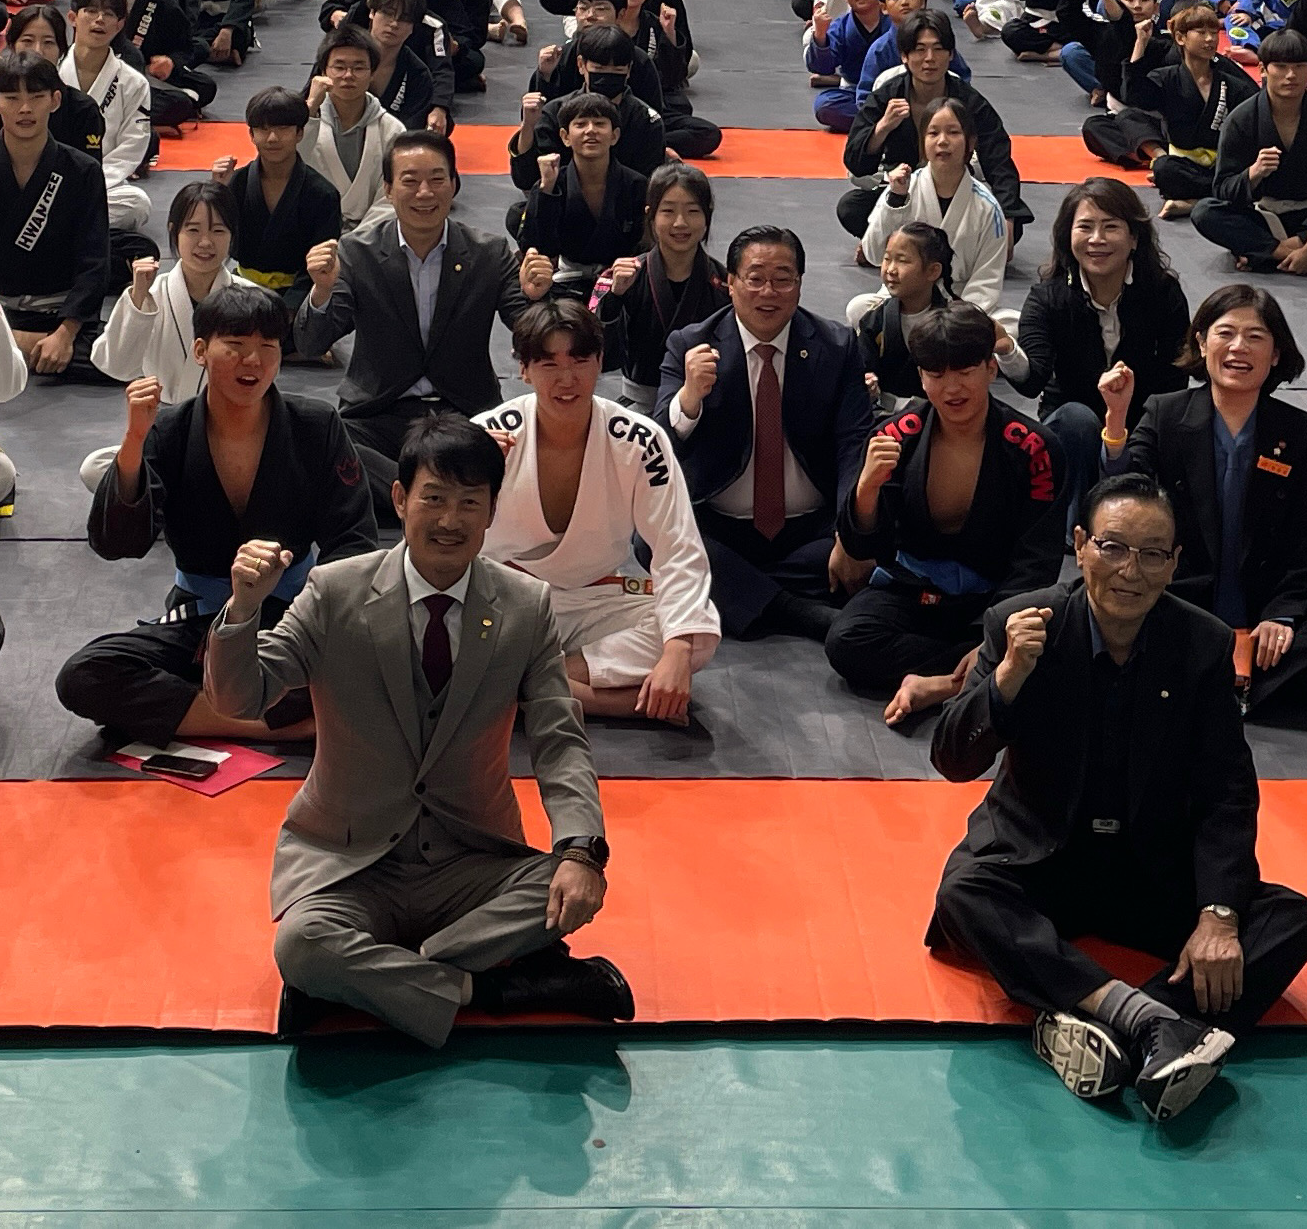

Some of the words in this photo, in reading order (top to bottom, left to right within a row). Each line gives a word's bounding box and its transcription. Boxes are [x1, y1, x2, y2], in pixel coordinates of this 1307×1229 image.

[18, 203, 47, 250] HWAN
[608, 416, 669, 487] CREW
[1003, 421, 1055, 502] CREW
